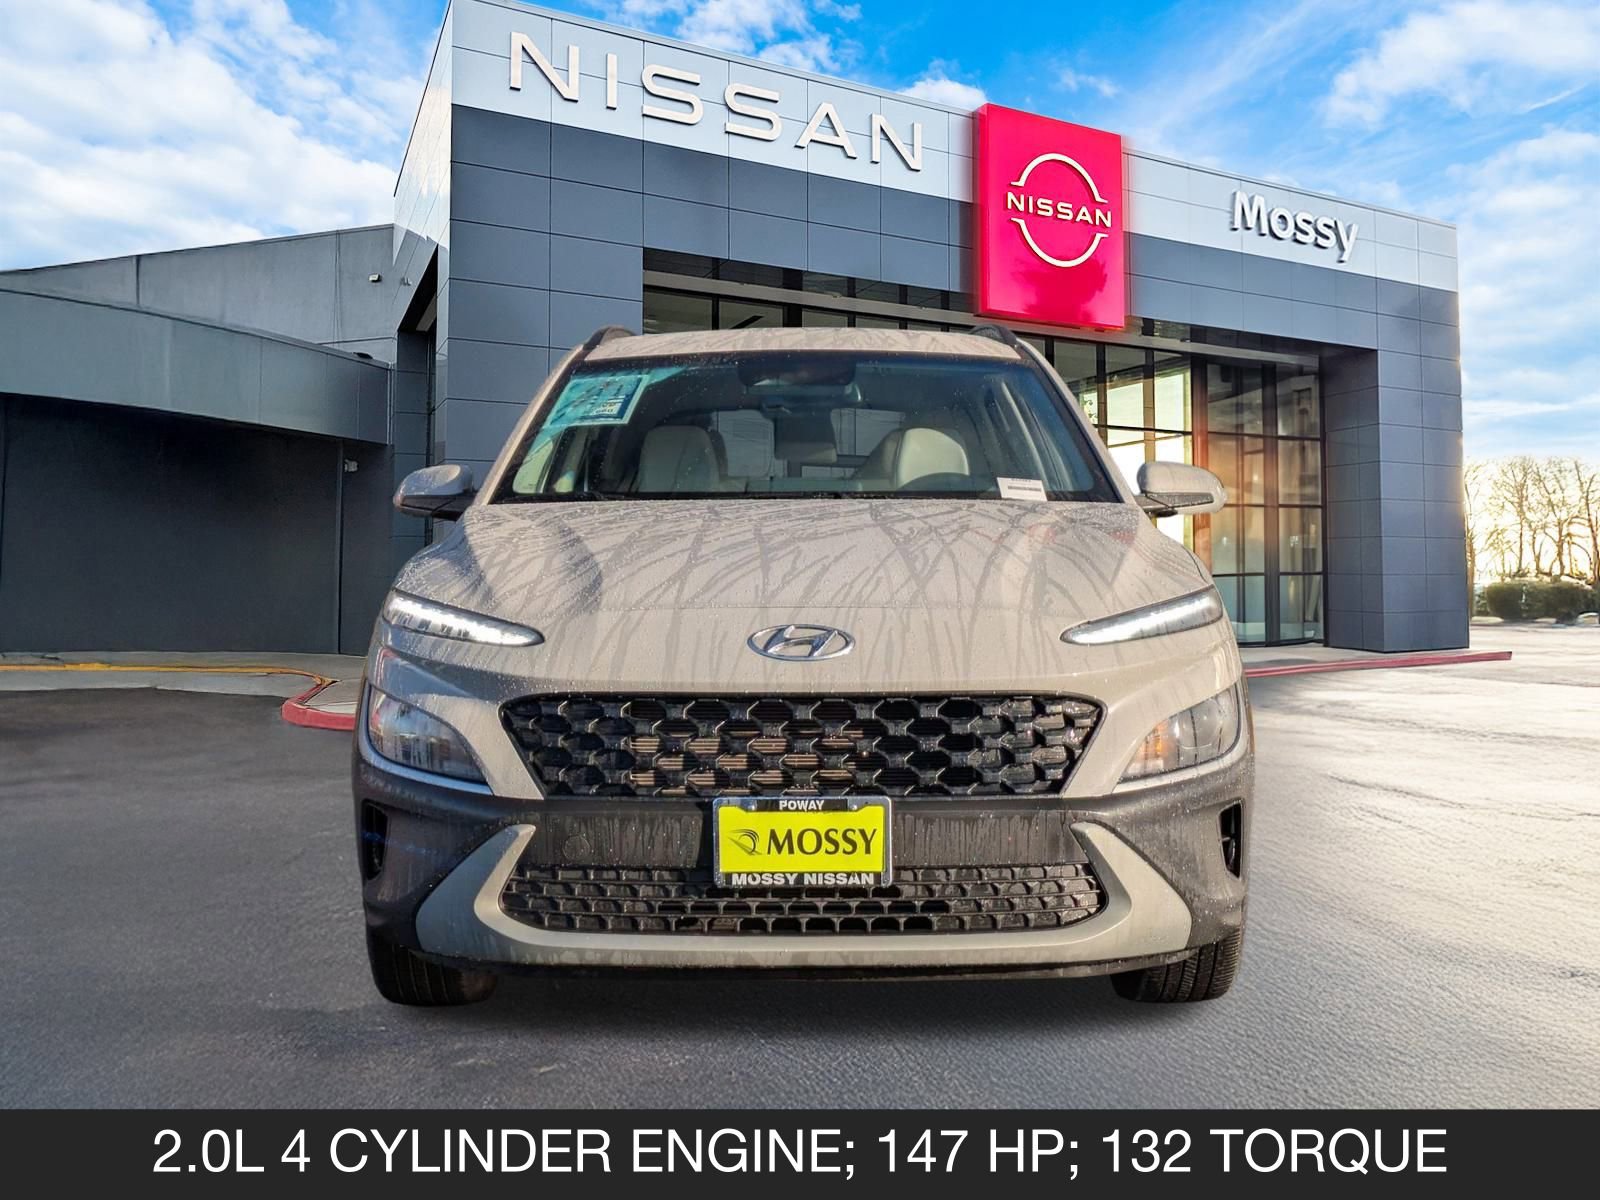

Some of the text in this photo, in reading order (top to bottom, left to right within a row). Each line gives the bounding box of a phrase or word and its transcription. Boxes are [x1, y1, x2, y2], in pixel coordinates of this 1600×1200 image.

[509, 31, 922, 172] NISSAN
[1006, 191, 1112, 228] NISSAN
[1231, 189, 1359, 263] Mossy
[779, 800, 824, 811] POWAY
[767, 828, 877, 855] MOSSY
[731, 873, 874, 885] MOSSY NISSAN
